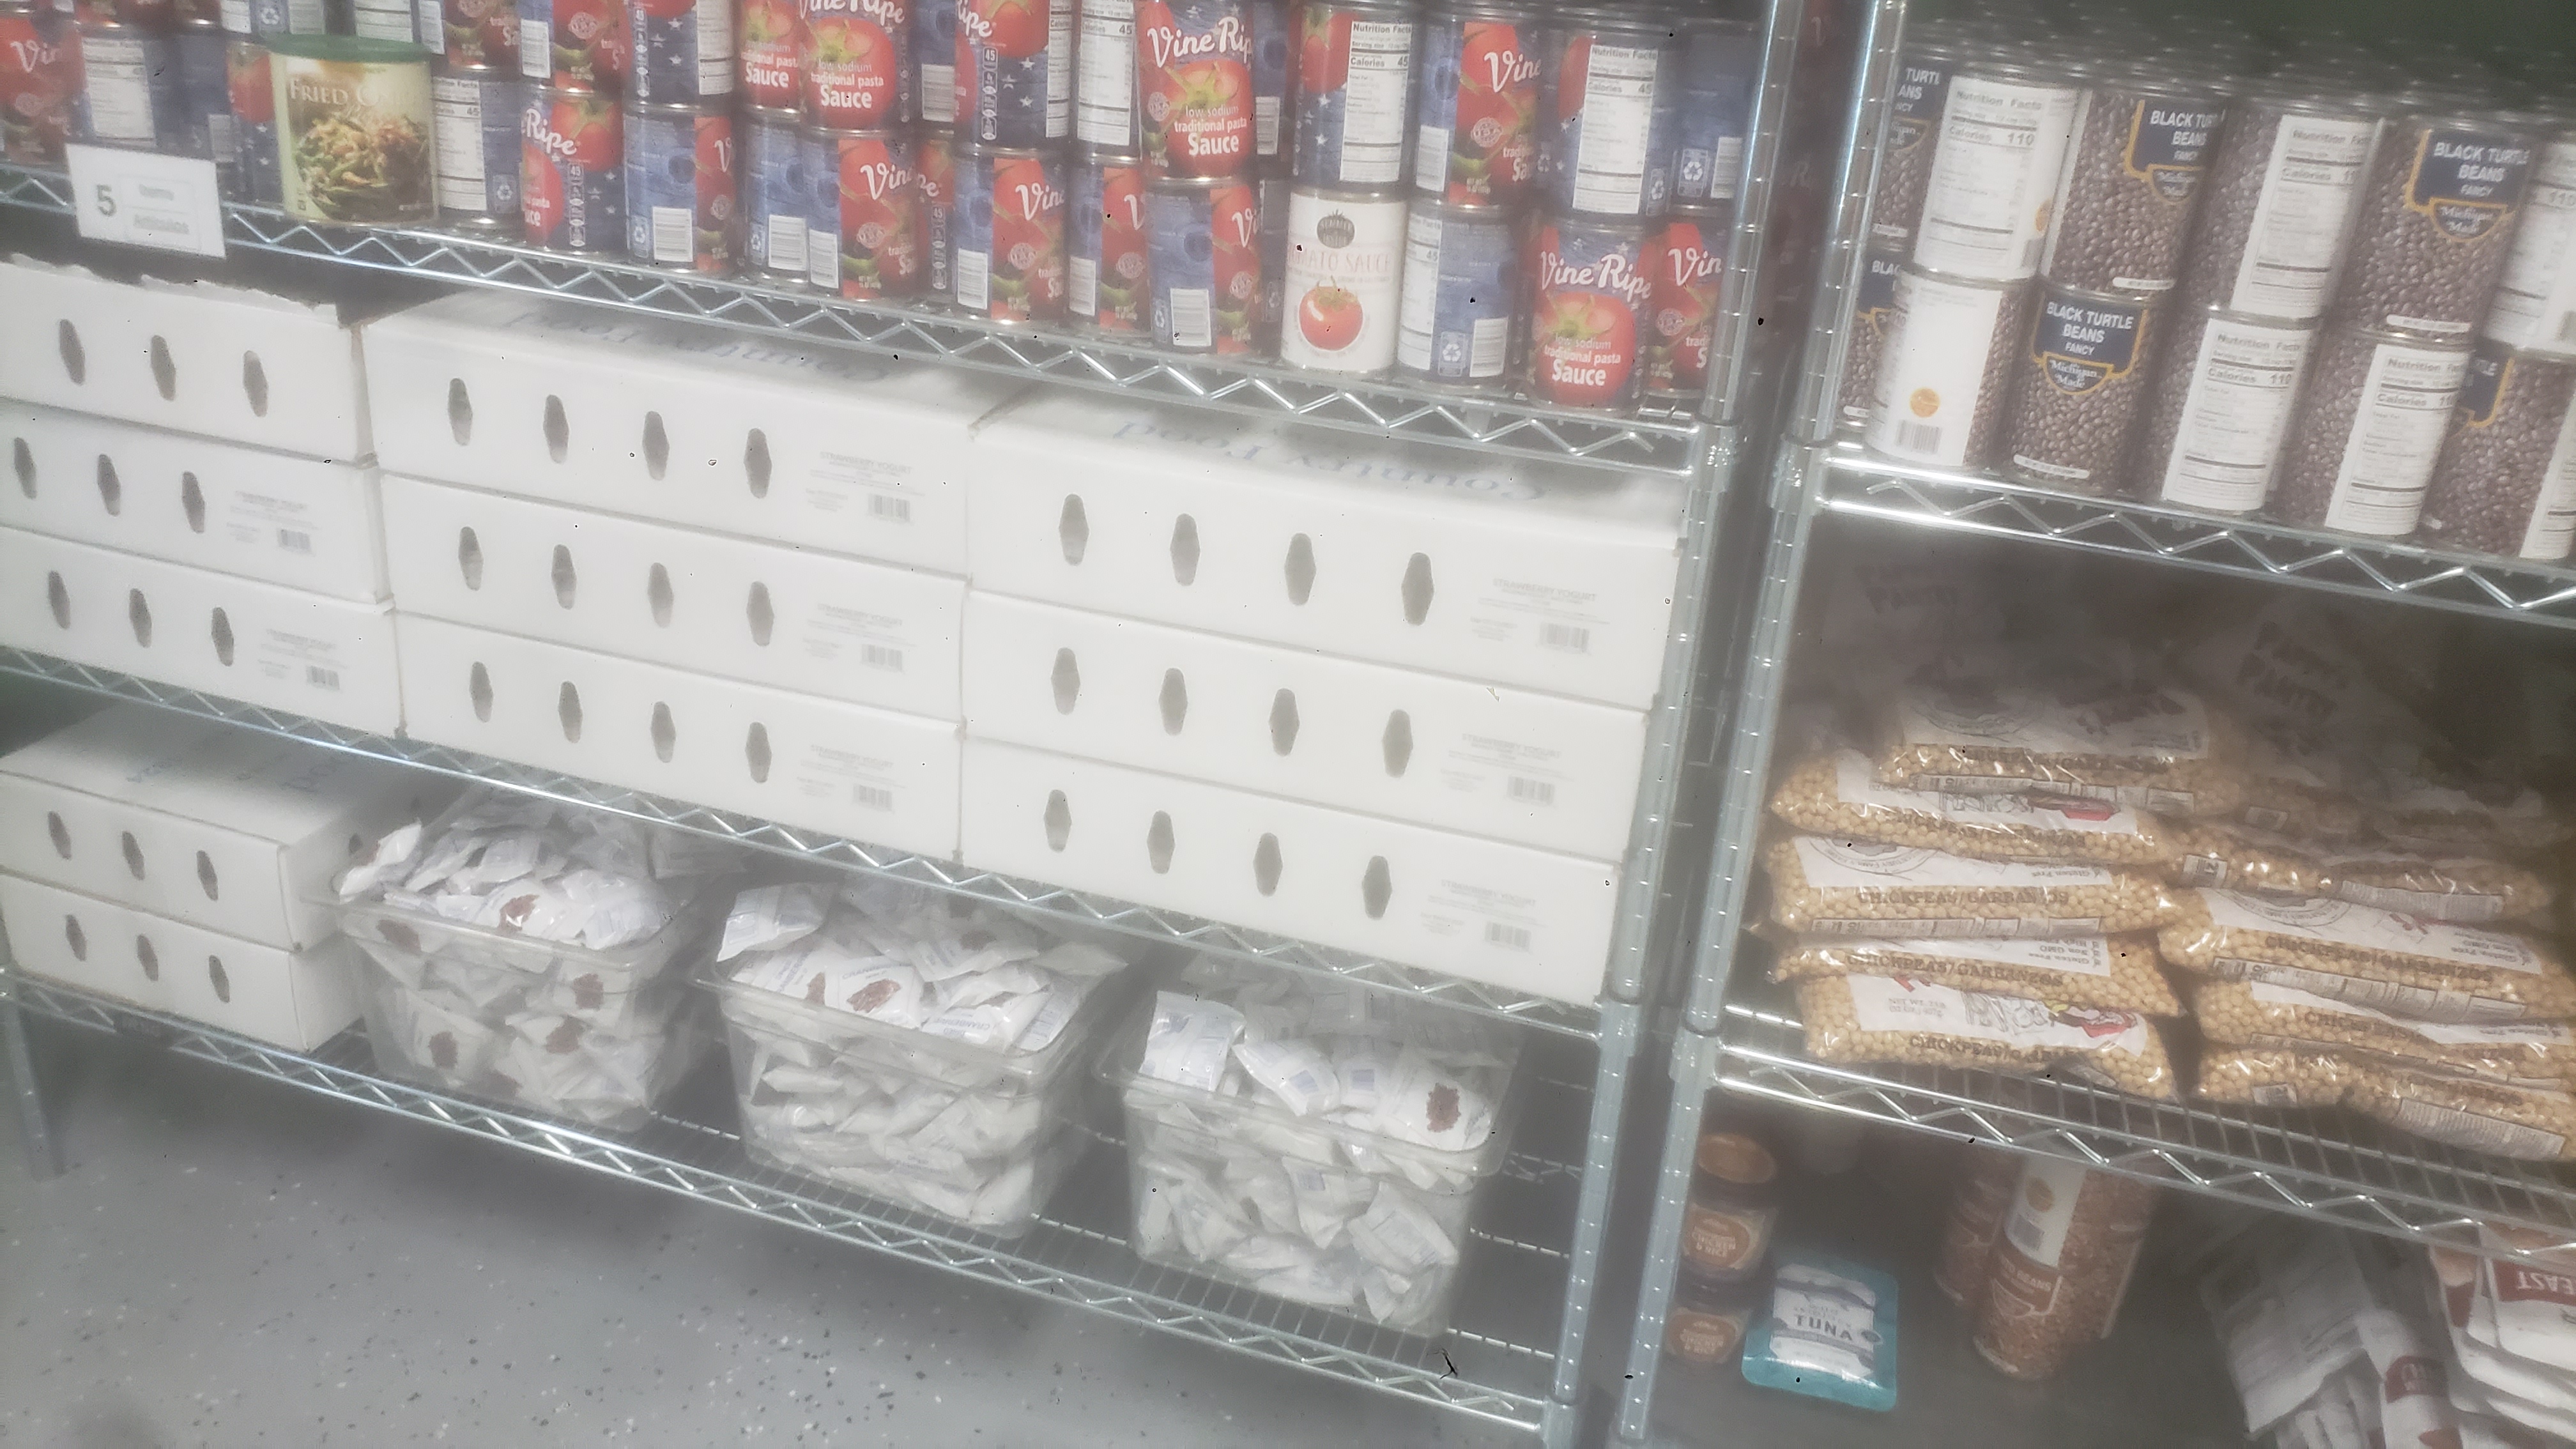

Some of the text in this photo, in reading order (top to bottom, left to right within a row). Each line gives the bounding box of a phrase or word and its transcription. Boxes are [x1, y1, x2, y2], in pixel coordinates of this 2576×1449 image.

[1119, 24, 1133, 35] 45
[1353, 23, 1390, 34] Nutrition
[1147, 16, 1252, 68] Vine Rip
[838, 61, 872, 72] sodium
[1351, 57, 1385, 68] Calories
[746, 62, 789, 88] Sauce
[811, 72, 884, 89] traditional pasta
[1905, 67, 1940, 84] TURTL
[289, 78, 349, 105] FRIED
[820, 84, 873, 109] Sauce
[1638, 84, 1652, 95] 45
[1897, 84, 1922, 100] ANS
[1186, 105, 1239, 118] low sodium
[1895, 102, 1913, 112] NCY
[1174, 118, 1225, 133] traditional
[2150, 110, 2194, 128] BLACK
[525, 108, 578, 155] Ripe
[2007, 132, 2035, 146] 110
[1188, 132, 1239, 157] Sauce
[2433, 141, 2485, 161] BLACK
[2457, 164, 2506, 183] BEANS
[96, 183, 117, 217] 5
[1346, 252, 1391, 273] SAUCE
[1668, 247, 1722, 286] Vin
[1872, 259, 1901, 275] BLAC
[1540, 251, 1652, 303] Vine Ripe
[2046, 302, 2135, 330] BLACK TURTLE
[2062, 323, 2106, 344] BEANS
[2217, 333, 2270, 349] Nutrition
[1575, 337, 1611, 350] sodium
[2065, 342, 2095, 356] FANCY
[1544, 344, 1621, 366] traditional pasta
[1551, 358, 1607, 387] Sauce
[2049, 359, 2102, 378] Michigan
[2387, 358, 2441, 372] Nutrition
[2055, 372, 2086, 389] Made
[2207, 367, 2292, 385] Calories 110
[2377, 392, 2428, 407] Calories
[877, 461, 913, 475] YOGURT
[1492, 578, 1597, 602] STRAWBERRY YOGURT
[1857, 890, 2069, 905] CHICKPEAS/GARBANOS
[2038, 944, 2065, 953] GMO
[2054, 955, 2090, 965] Gluten
[1797, 1314, 1853, 1341] TUNA
